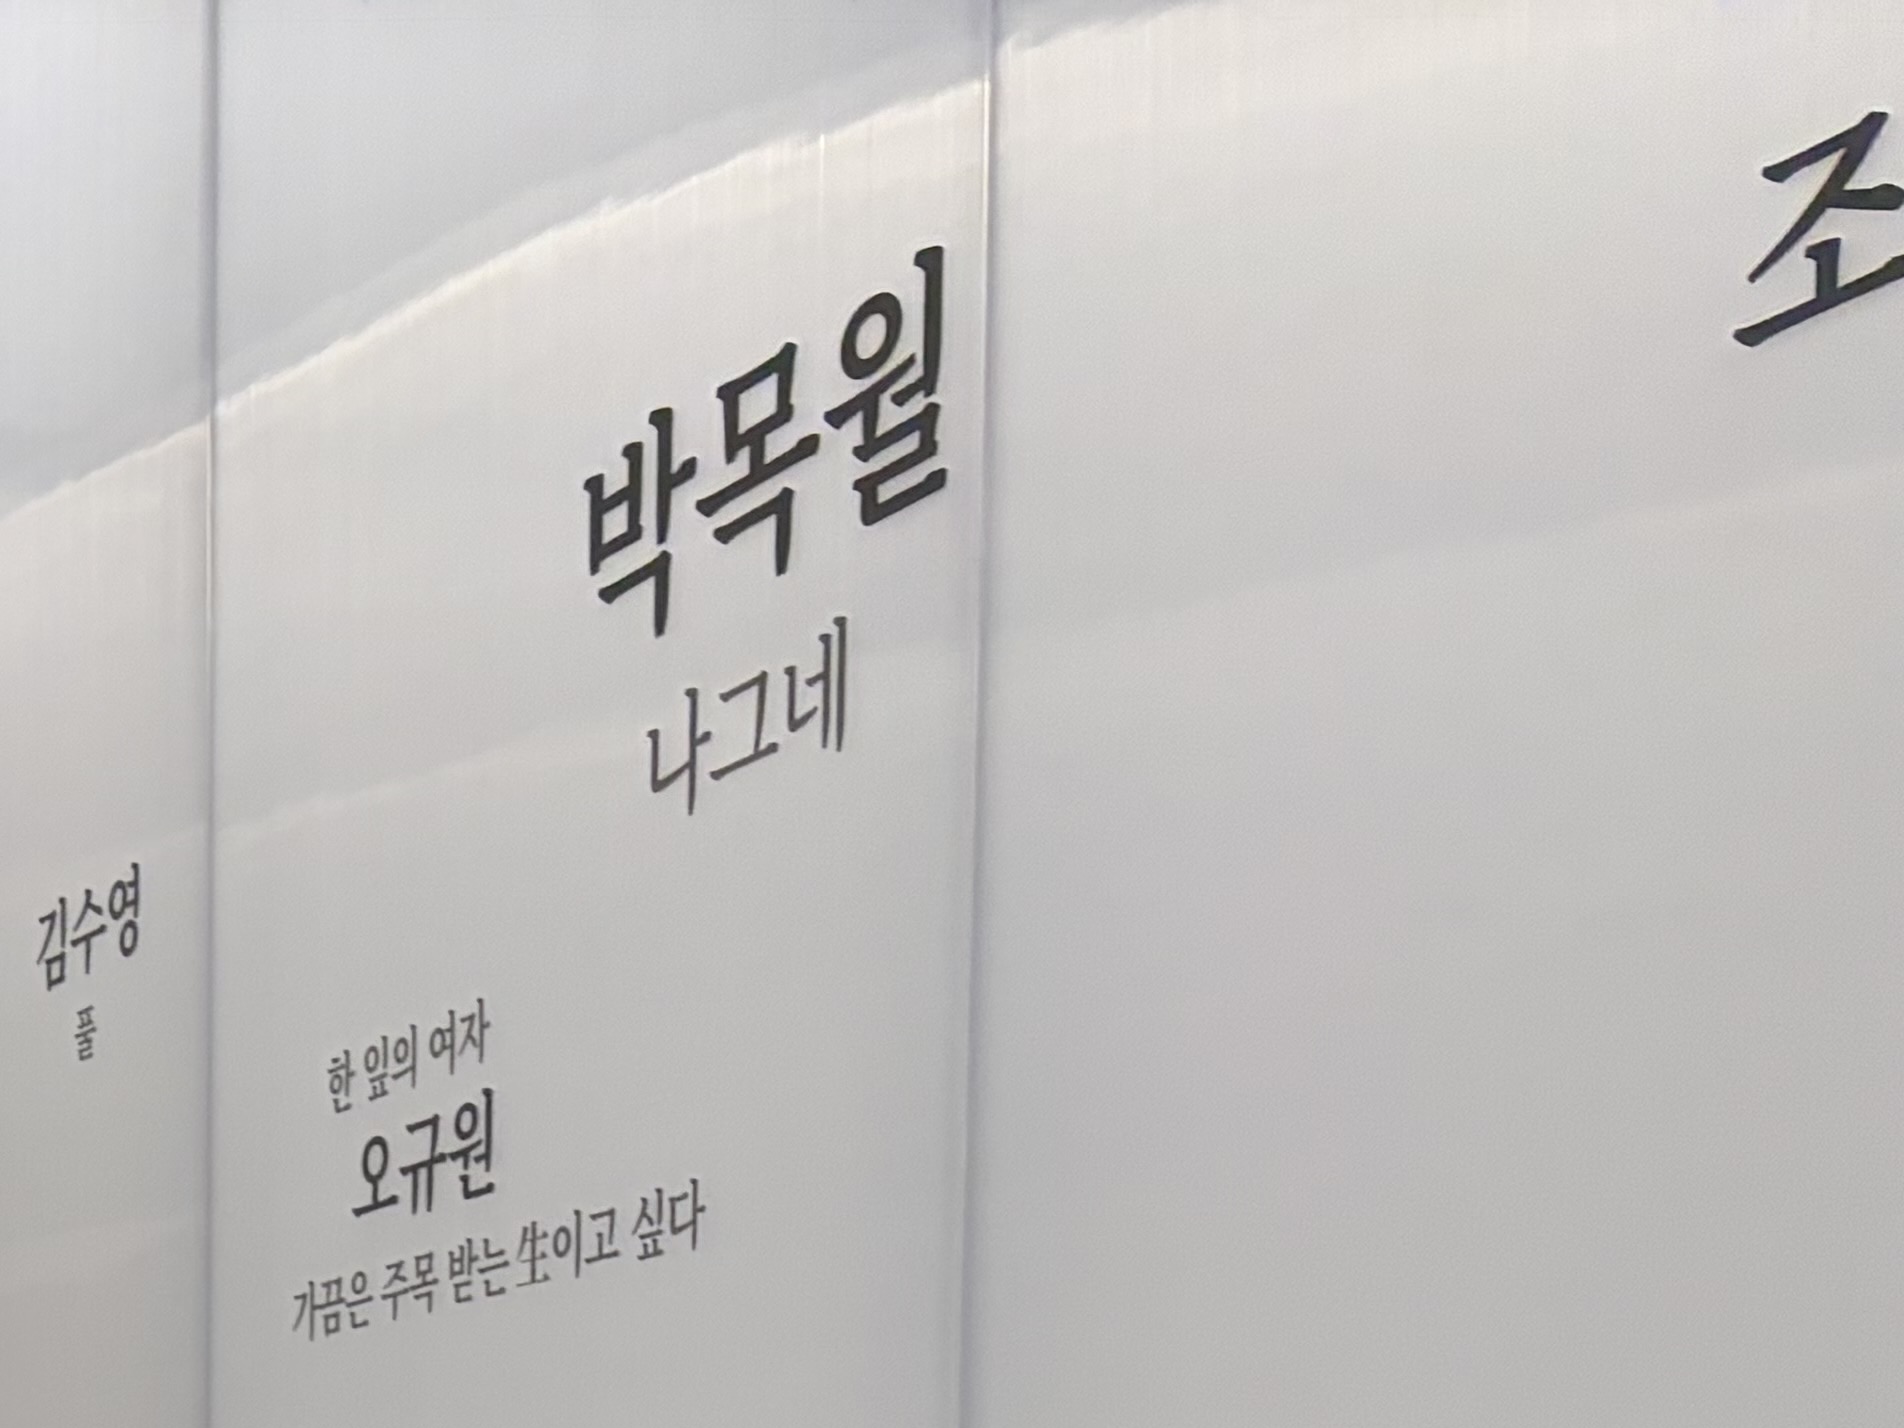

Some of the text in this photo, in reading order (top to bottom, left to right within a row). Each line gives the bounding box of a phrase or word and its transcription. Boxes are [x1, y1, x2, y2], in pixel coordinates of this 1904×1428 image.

[582, 245, 948, 638] 박목월
[646, 615, 848, 817] 나그네
[36, 862, 140, 992] 김수영
[74, 1004, 98, 1062] 풀
[327, 997, 491, 1114] 한 잎의 여자
[351, 1087, 496, 1218] 오규원
[293, 1270, 375, 1342] 가끔은
[380, 1251, 440, 1321] 주목
[447, 1237, 511, 1304] 받는
[631, 1177, 707, 1261] 싶다
